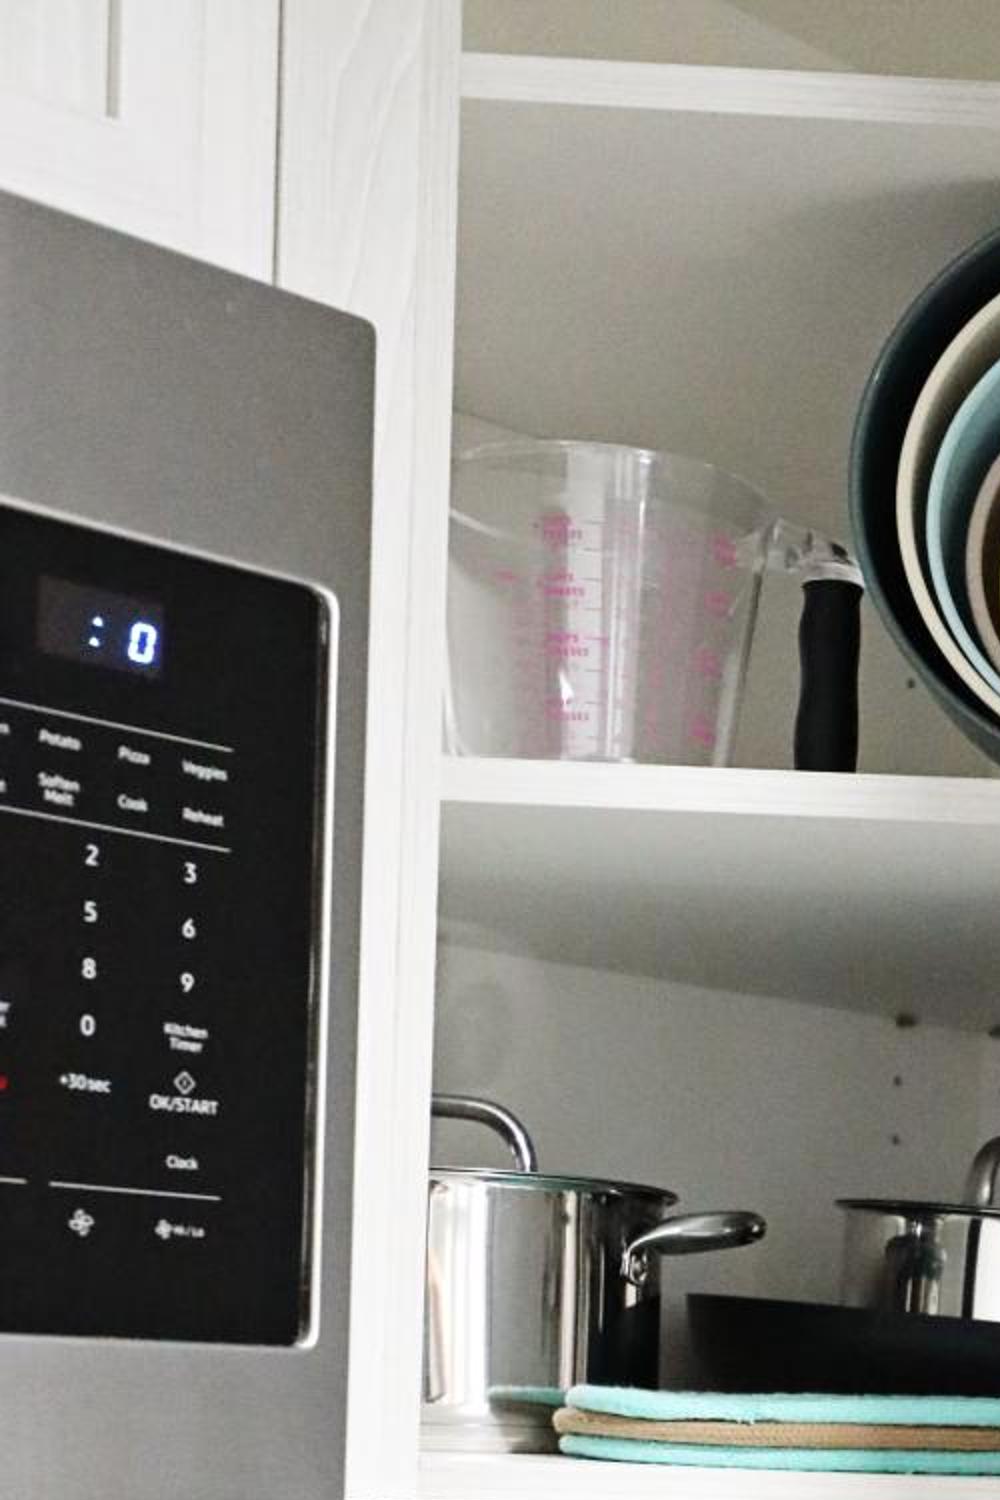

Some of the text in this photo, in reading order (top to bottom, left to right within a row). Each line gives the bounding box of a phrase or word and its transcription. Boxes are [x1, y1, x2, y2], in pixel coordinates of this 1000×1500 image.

[39, 728, 82, 752] Potato
[117, 745, 151, 766] Pizza
[117, 793, 149, 812] Cook
[182, 806, 225, 827] Reheat
[85, 844, 99, 867] 2
[184, 862, 197, 884] 3
[84, 900, 98, 923] 5
[181, 918, 196, 940] 6
[81, 957, 97, 980] 8
[180, 972, 195, 993] 9
[79, 1014, 96, 1037] 0
[163, 1022, 208, 1040] Kitchen
[169, 1036, 203, 1053] Timer
[148, 1093, 219, 1116] OK/START
[165, 1154, 199, 1170] Clock
